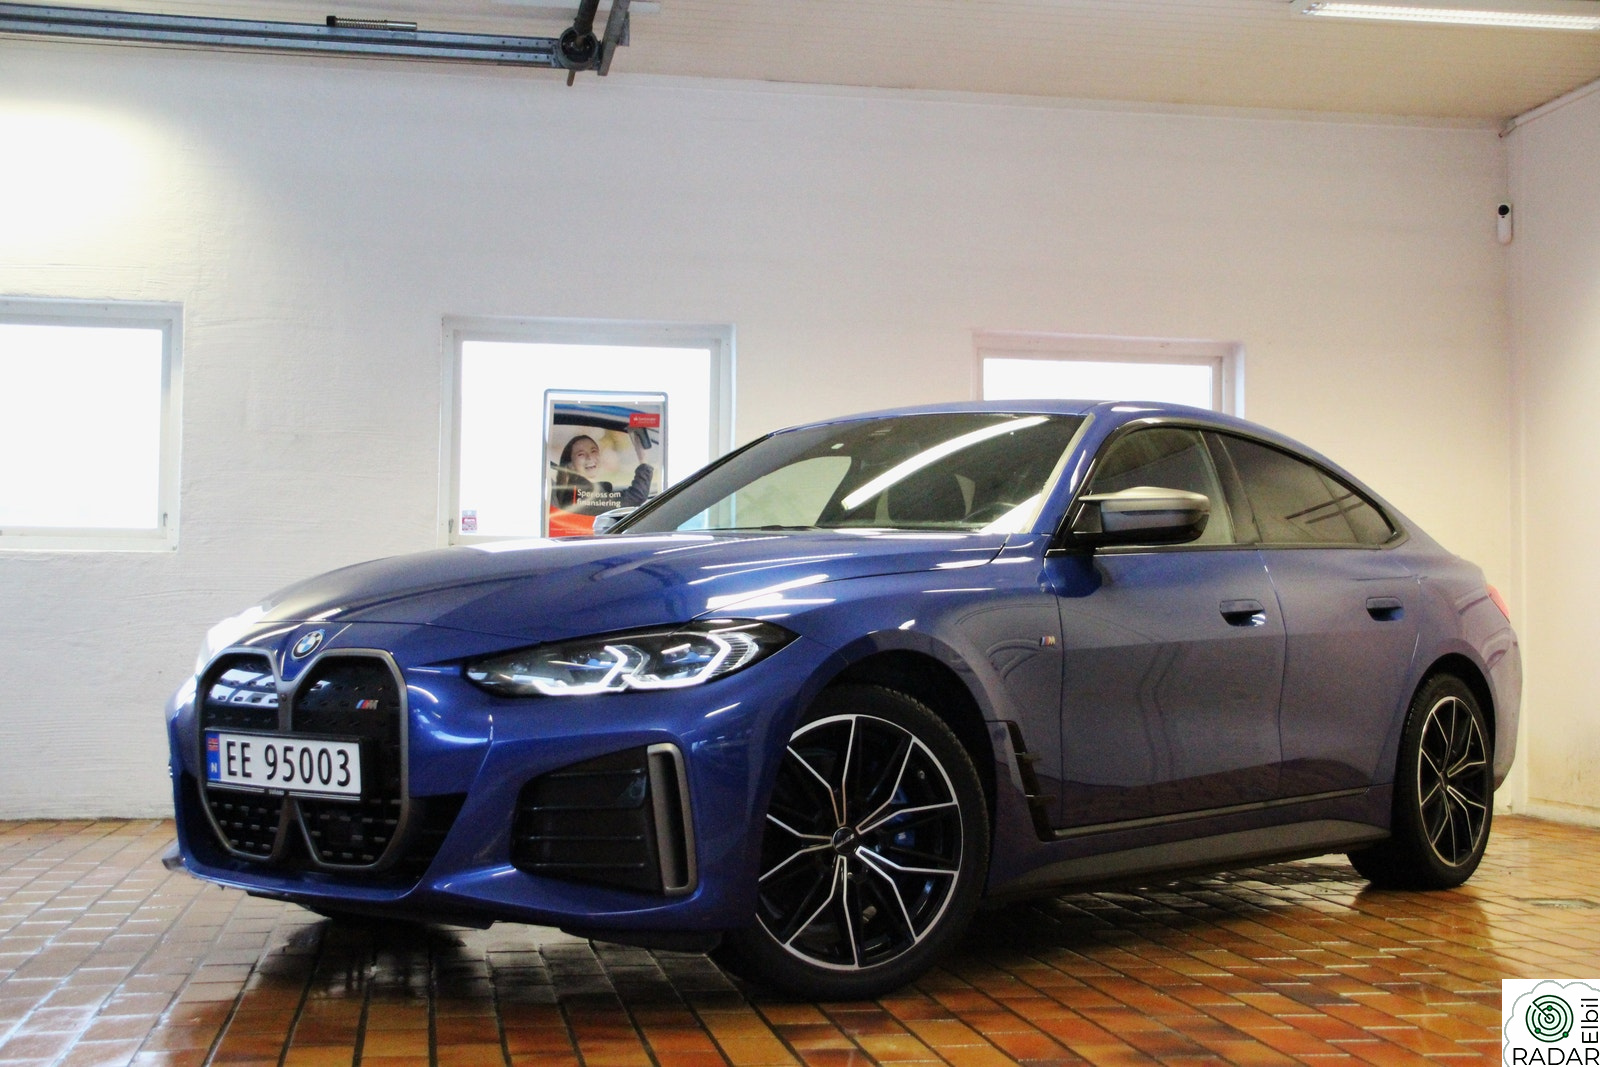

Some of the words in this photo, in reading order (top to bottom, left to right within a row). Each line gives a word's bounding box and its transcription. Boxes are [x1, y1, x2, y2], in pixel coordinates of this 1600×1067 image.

[577, 498, 621, 508] finansiering
[210, 762, 218, 773] N
[226, 740, 252, 778] EE
[264, 744, 351, 787] 95003
